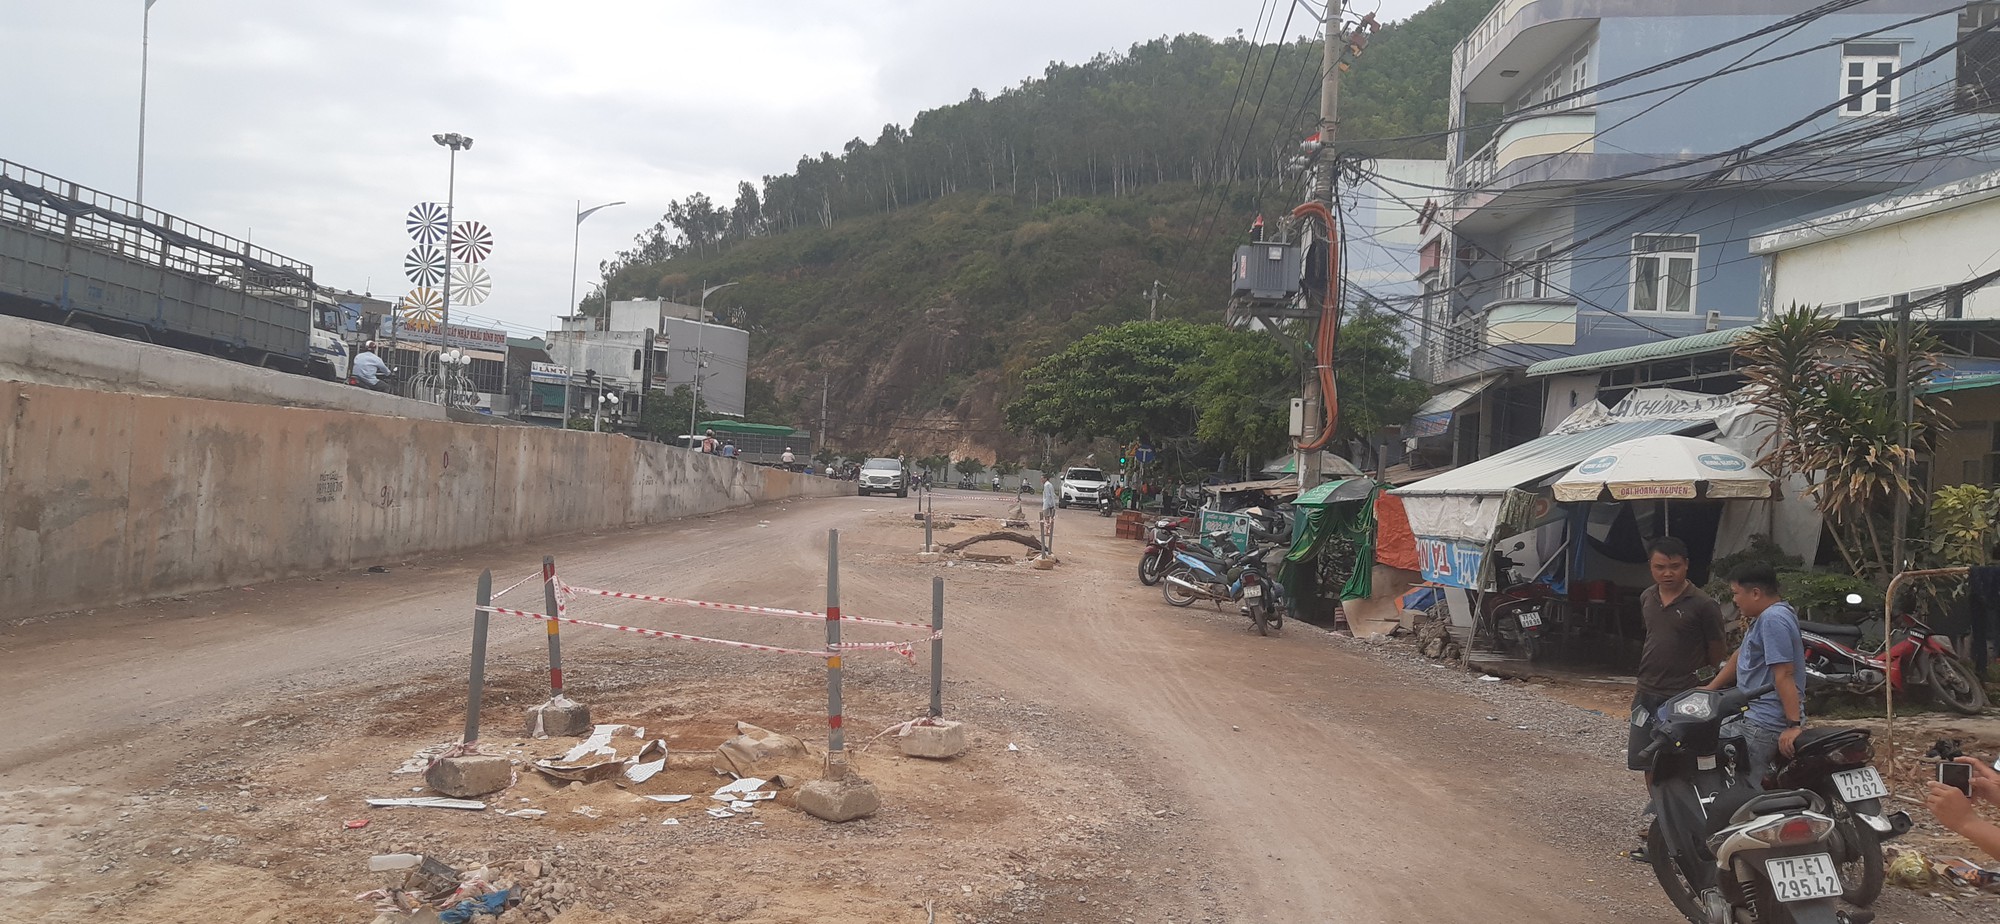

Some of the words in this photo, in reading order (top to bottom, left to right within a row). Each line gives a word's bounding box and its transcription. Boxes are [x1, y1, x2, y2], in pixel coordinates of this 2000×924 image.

[482, 330, 494, 343] BÌNH
[494, 333, 505, 345] ĐỊNH
[1840, 769, 1874, 787] 77-X9
[1846, 782, 1881, 799] 2292
[1776, 857, 1825, 879] 77-E1
[1777, 876, 1839, 900] 295.42
